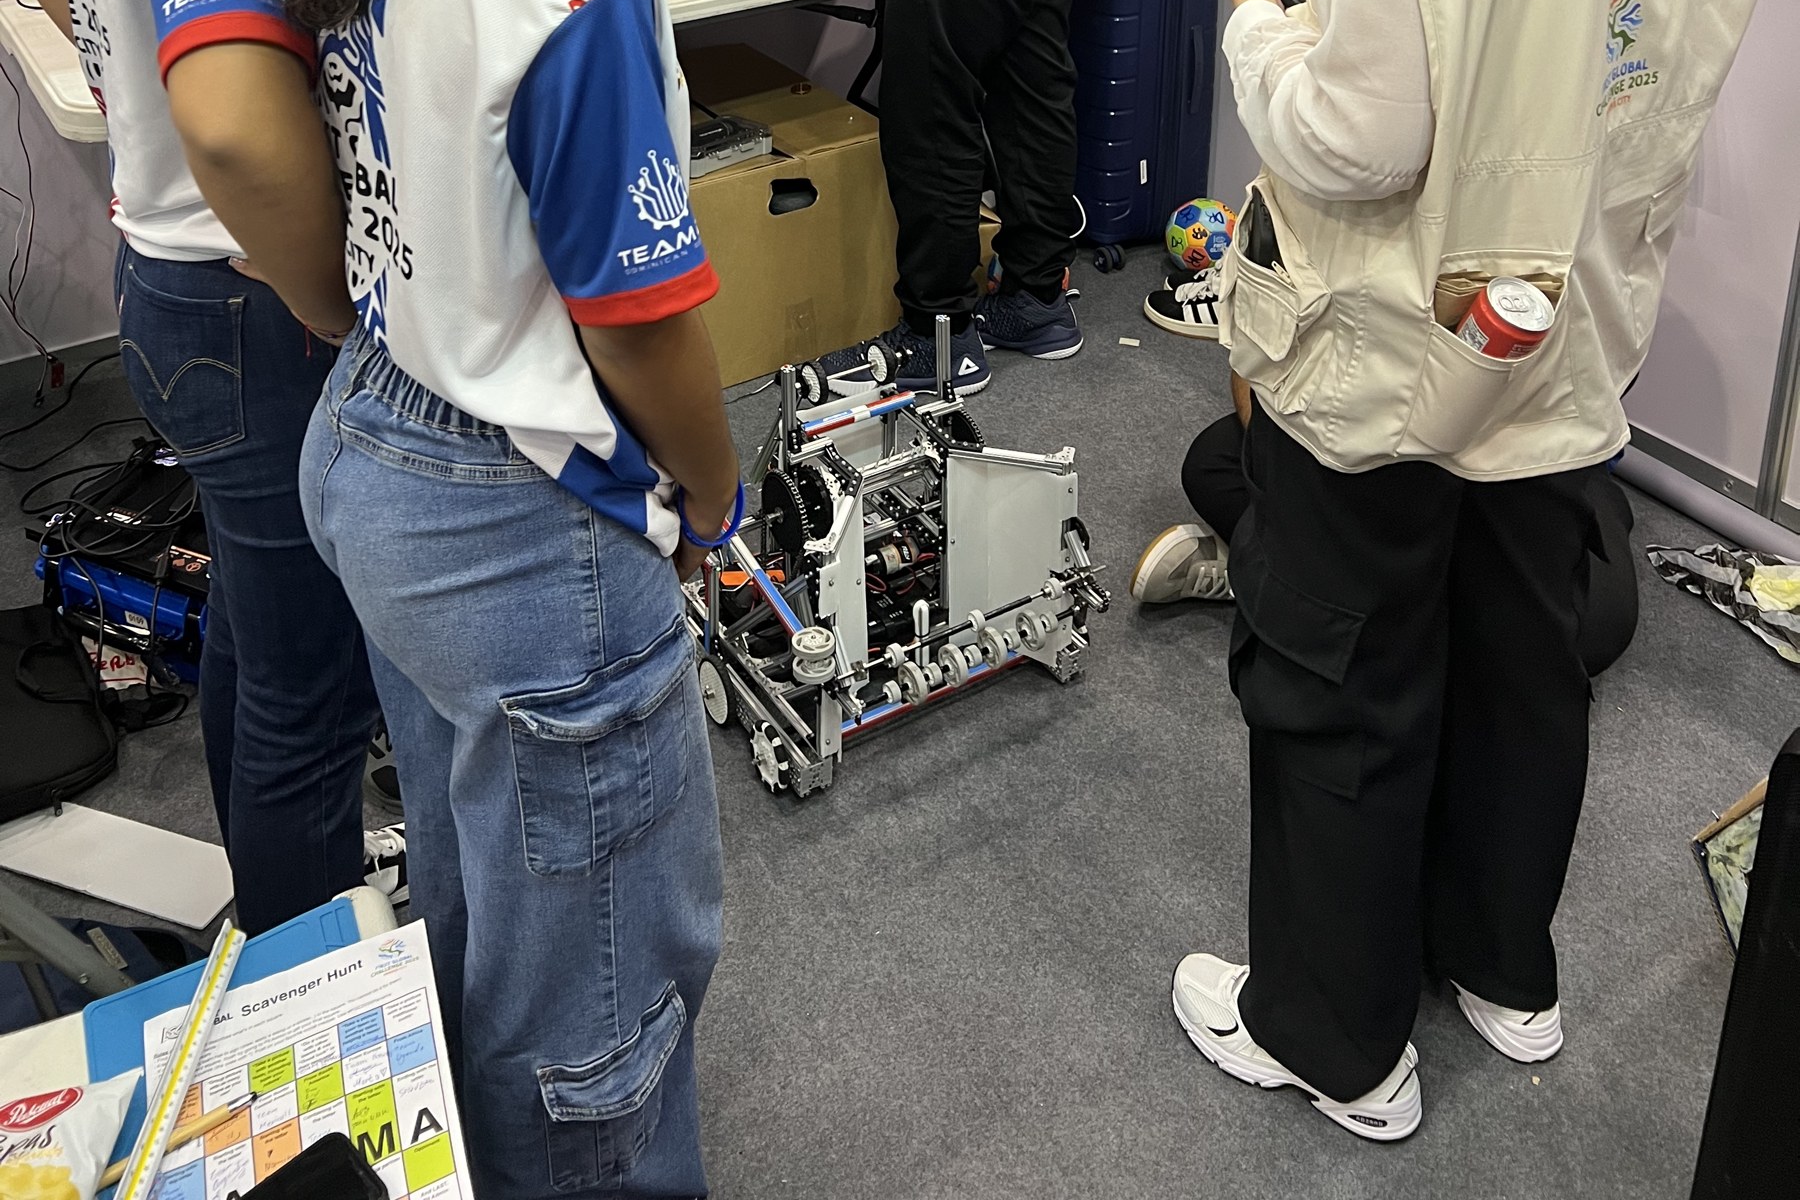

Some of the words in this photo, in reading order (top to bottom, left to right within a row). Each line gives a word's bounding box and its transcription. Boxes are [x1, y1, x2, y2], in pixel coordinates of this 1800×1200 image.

[1628, 70, 1659, 90] 2025
[362, 206, 413, 280] 2025
[617, 225, 697, 267] TEAM
[241, 976, 322, 1017] Scavenger
[326, 959, 363, 984] Hunt
[357, 1121, 396, 1162] M
[410, 1107, 443, 1144] A
